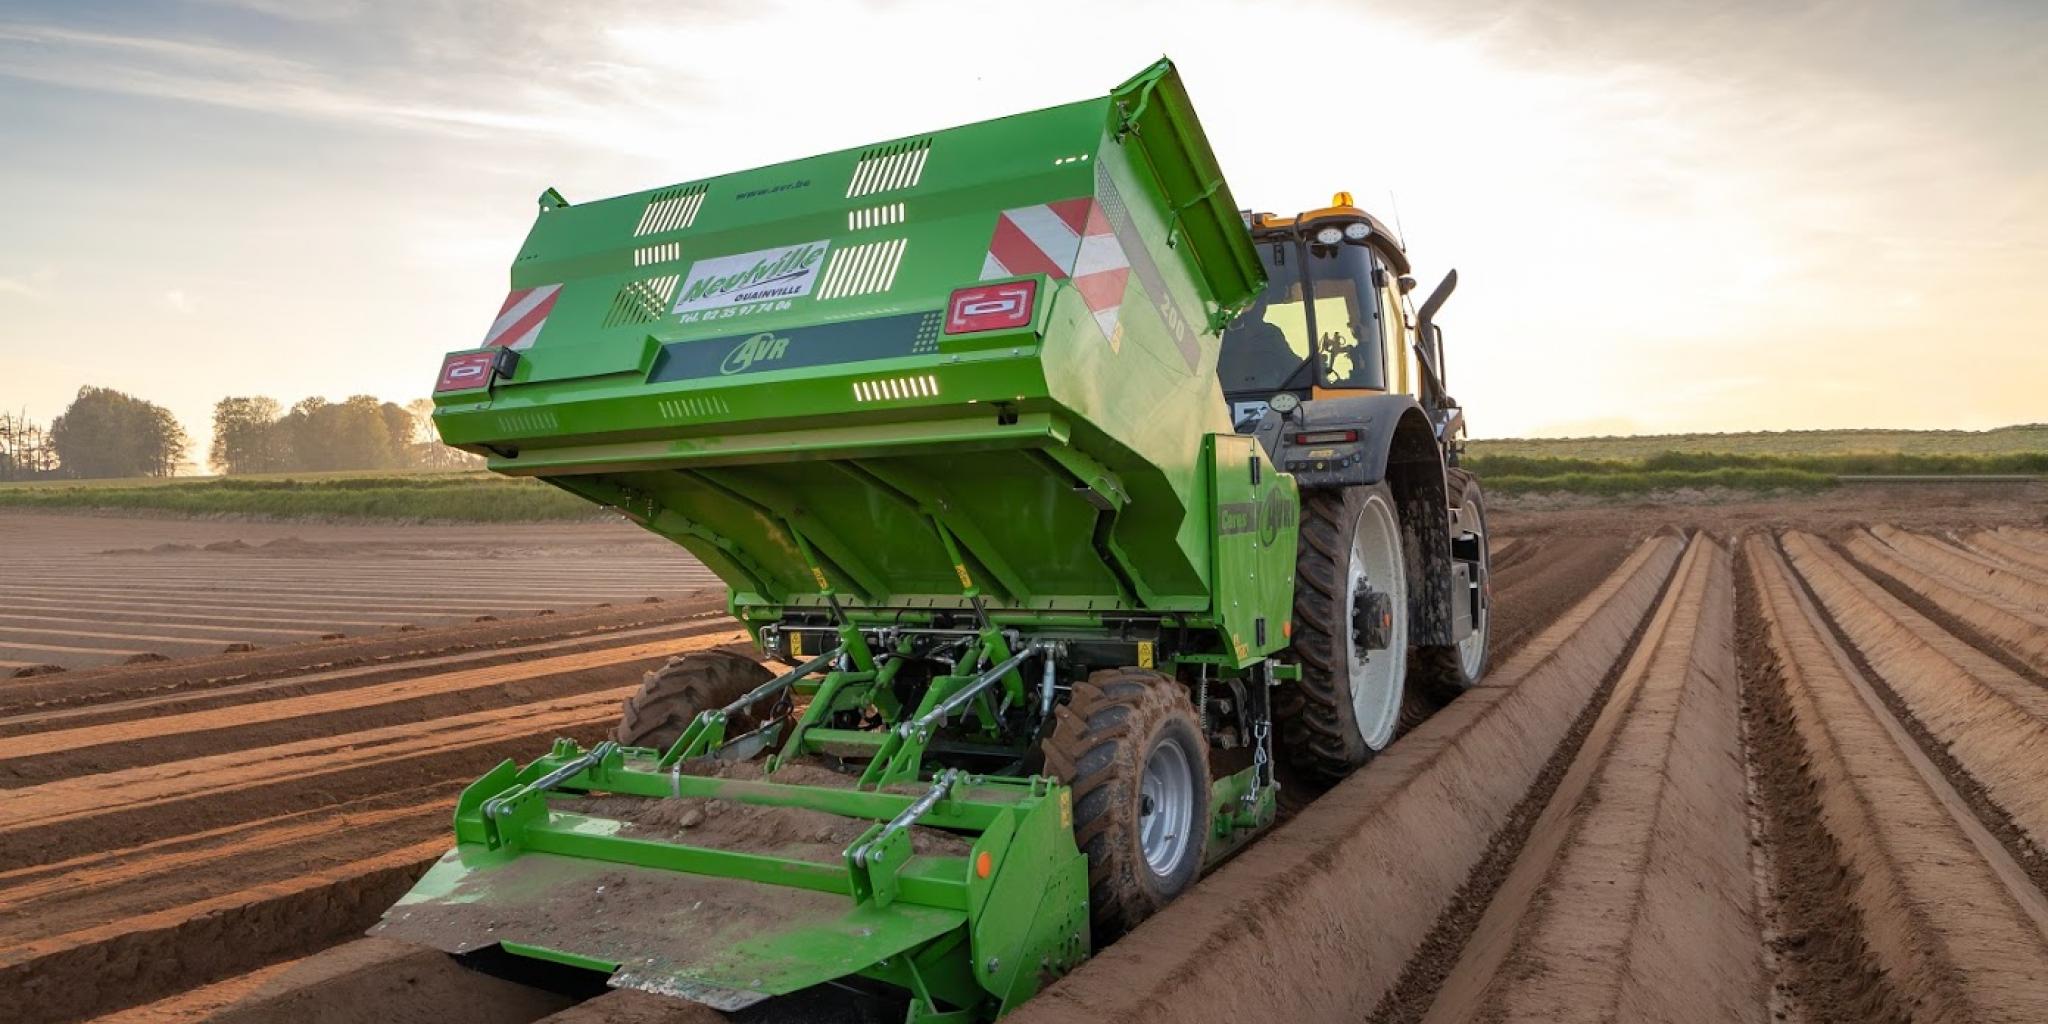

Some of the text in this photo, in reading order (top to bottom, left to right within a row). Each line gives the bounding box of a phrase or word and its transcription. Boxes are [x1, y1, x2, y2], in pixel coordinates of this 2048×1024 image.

[736, 179, 811, 200] www.avr.be
[679, 244, 825, 306] Neufville
[734, 286, 801, 302] OUAINVILLE
[702, 310, 718, 321] 02
[720, 307, 735, 318] 35
[738, 304, 753, 316] 97
[756, 302, 772, 313] 74
[1161, 291, 1185, 342] 200
[721, 333, 790, 374] AVR
